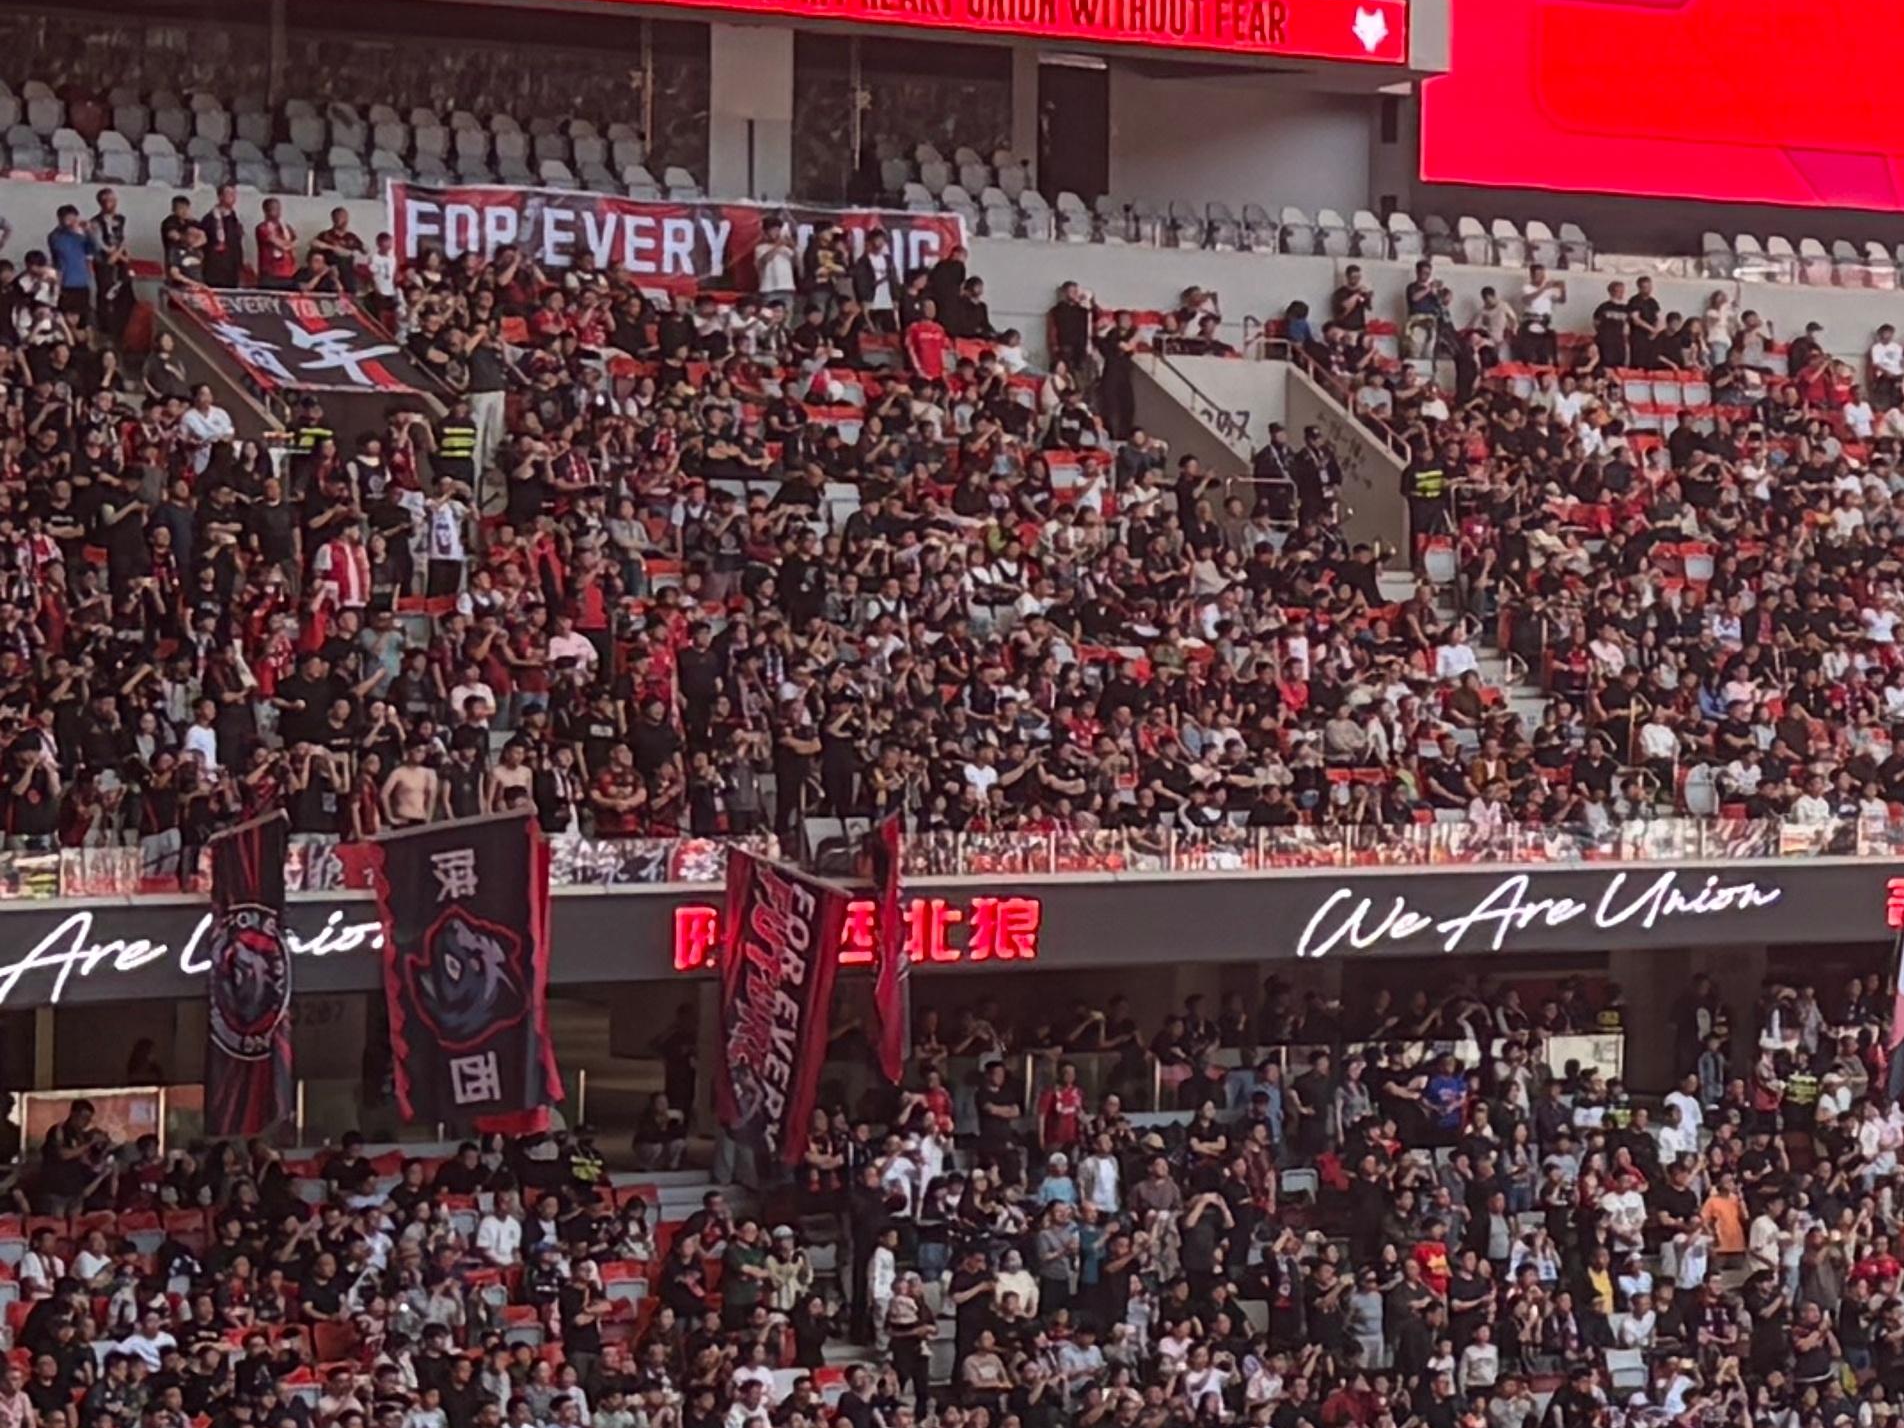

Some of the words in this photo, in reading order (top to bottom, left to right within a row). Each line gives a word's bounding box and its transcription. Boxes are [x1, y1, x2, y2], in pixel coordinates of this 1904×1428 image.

[405, 200, 518, 262] FOR
[542, 206, 733, 278] EVERY
[0, 911, 167, 1004] Are
[1297, 887, 1429, 959] We
[1437, 873, 1587, 954] Are
[1594, 870, 1782, 931] Union
